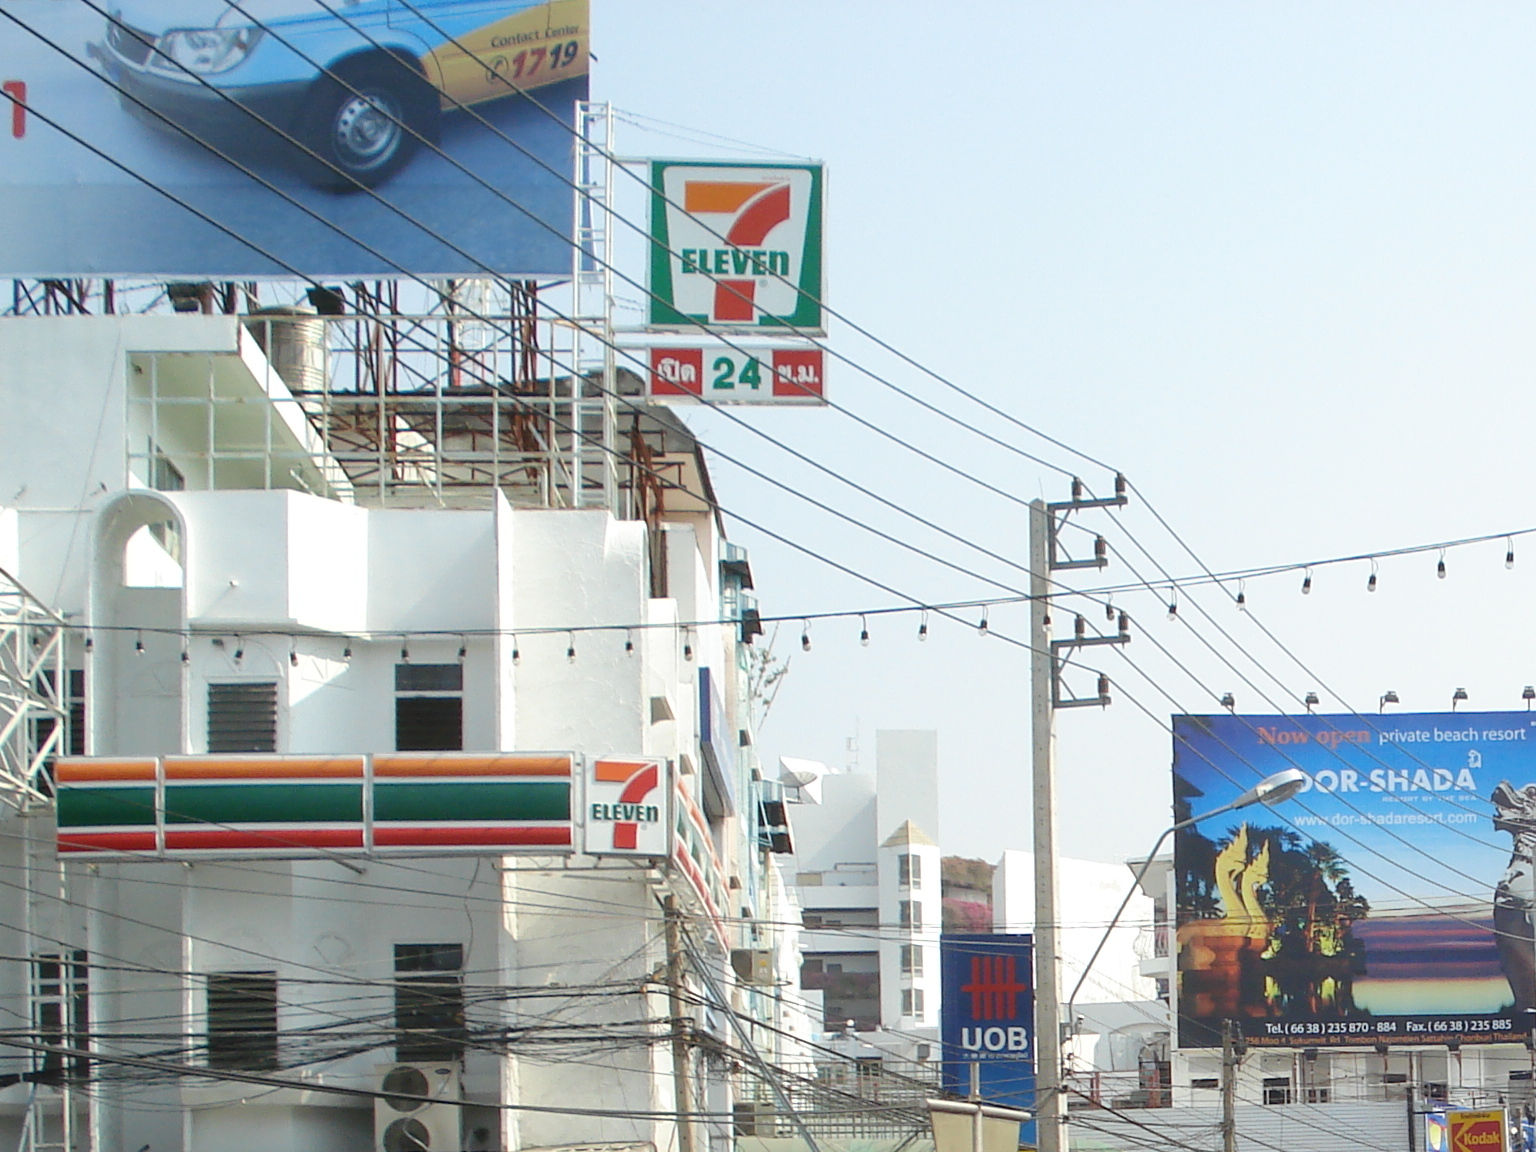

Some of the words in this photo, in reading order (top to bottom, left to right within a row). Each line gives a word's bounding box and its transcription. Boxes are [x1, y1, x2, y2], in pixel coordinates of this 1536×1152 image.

[491, 31, 539, 47] Contact
[545, 25, 579, 38] Center
[513, 41, 578, 79] 1719
[712, 356, 762, 391] 24
[1257, 726, 1309, 745] Now
[1315, 730, 1371, 749] open
[1379, 728, 1430, 746] private
[1434, 727, 1479, 742] beach
[1482, 728, 1526, 741] resort
[1299, 768, 1477, 793] DOR-SHADA
[1294, 811, 1478, 827] www.dor-shadaresort.com
[1290, 1023, 1304, 1034] 66
[1306, 1022, 1320, 1034] 38
[1327, 1022, 1347, 1034] 235
[1348, 1022, 1369, 1033] 870
[1376, 1021, 1397, 1033] 884
[1433, 1021, 1447, 1032] 66
[1450, 1020, 1462, 1032] 38
[1470, 1020, 1490, 1031] 235
[1492, 1019, 1512, 1031] 885
[961, 1026, 1028, 1051] UOB
[1463, 1131, 1500, 1146] Kodak
